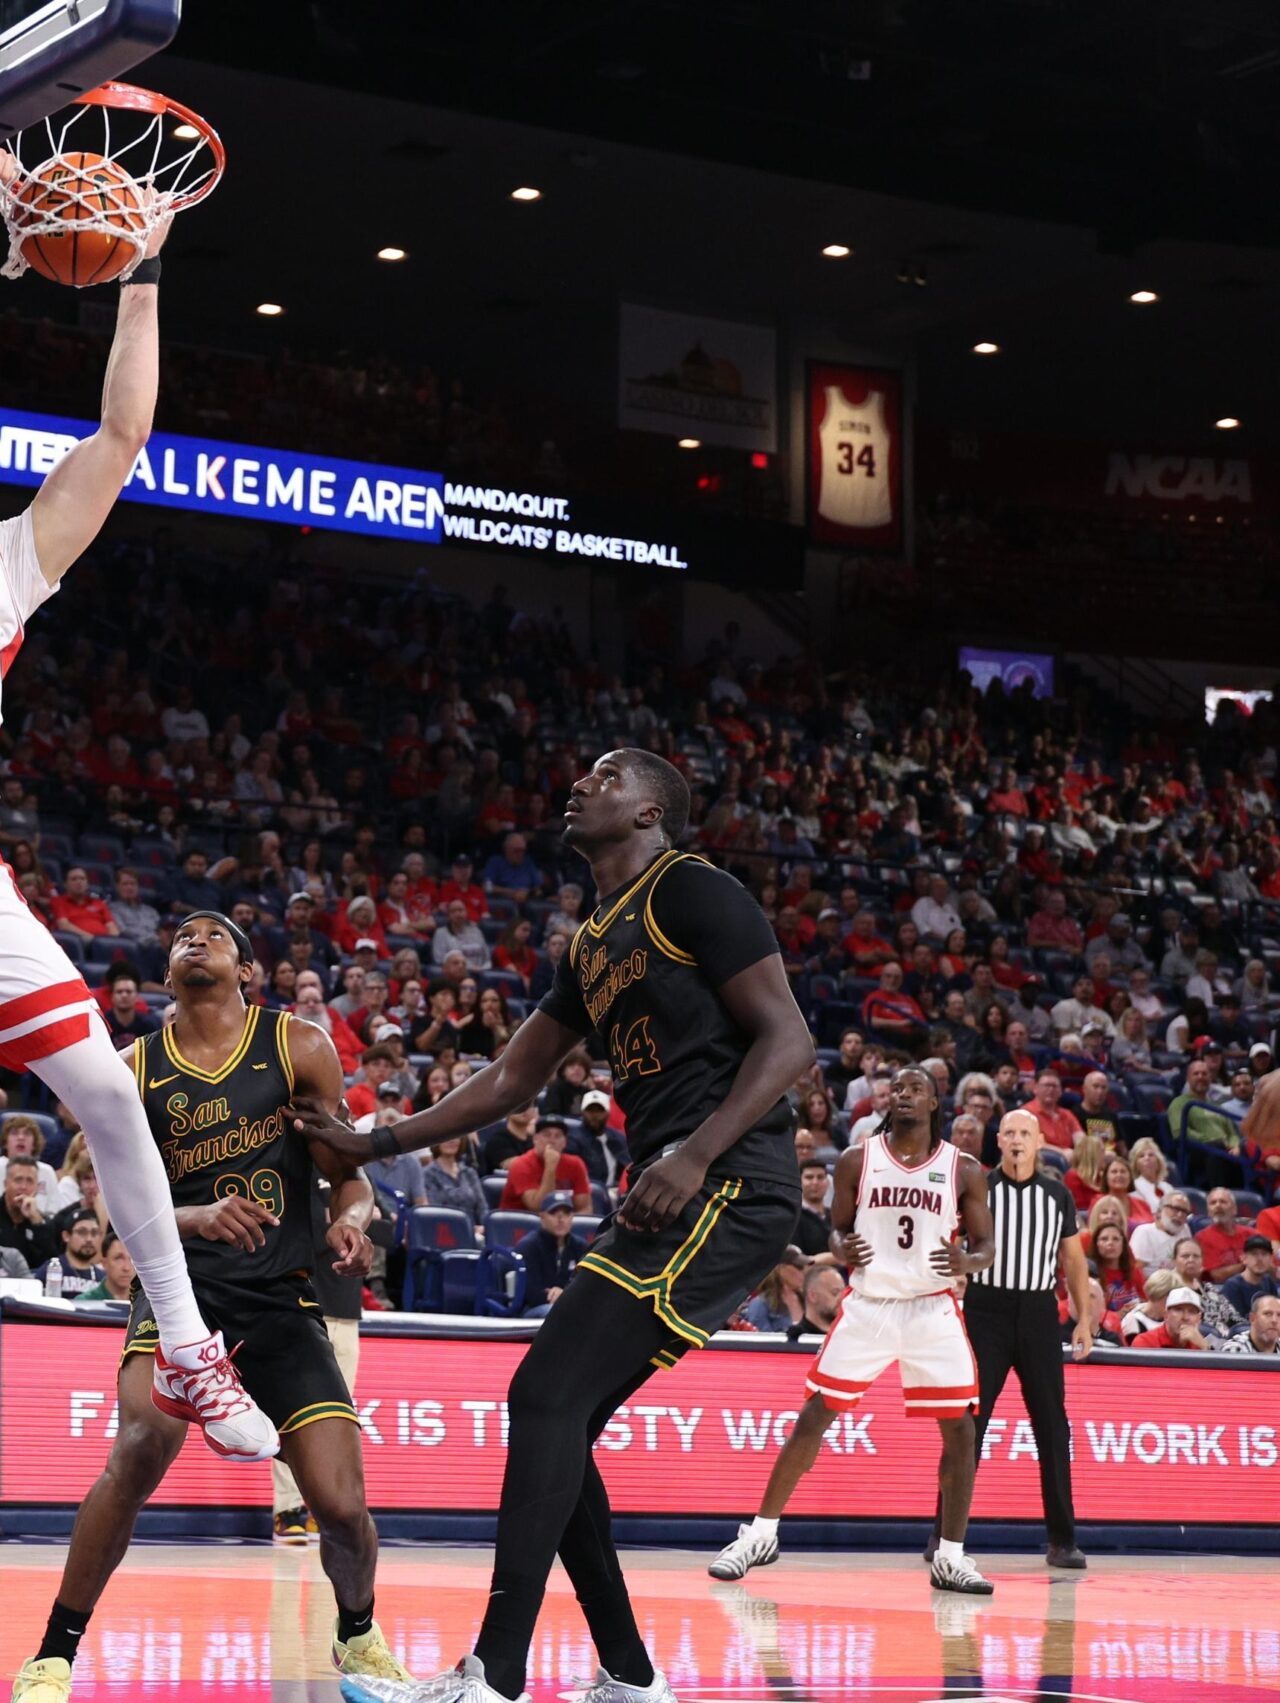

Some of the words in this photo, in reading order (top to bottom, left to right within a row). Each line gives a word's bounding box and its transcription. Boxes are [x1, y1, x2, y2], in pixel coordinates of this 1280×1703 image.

[837, 443, 876, 478] 34
[1105, 452, 1252, 504] NCAA
[555, 530, 689, 569] BASKETBALL.
[167, 1092, 231, 1137] San
[868, 1186, 942, 1216] ARIZONA
[898, 1215, 915, 1250] 3
[397, 1400, 447, 1447] IS
[1084, 1421, 1230, 1466] WORK
[1238, 1426, 1278, 1467] IS
